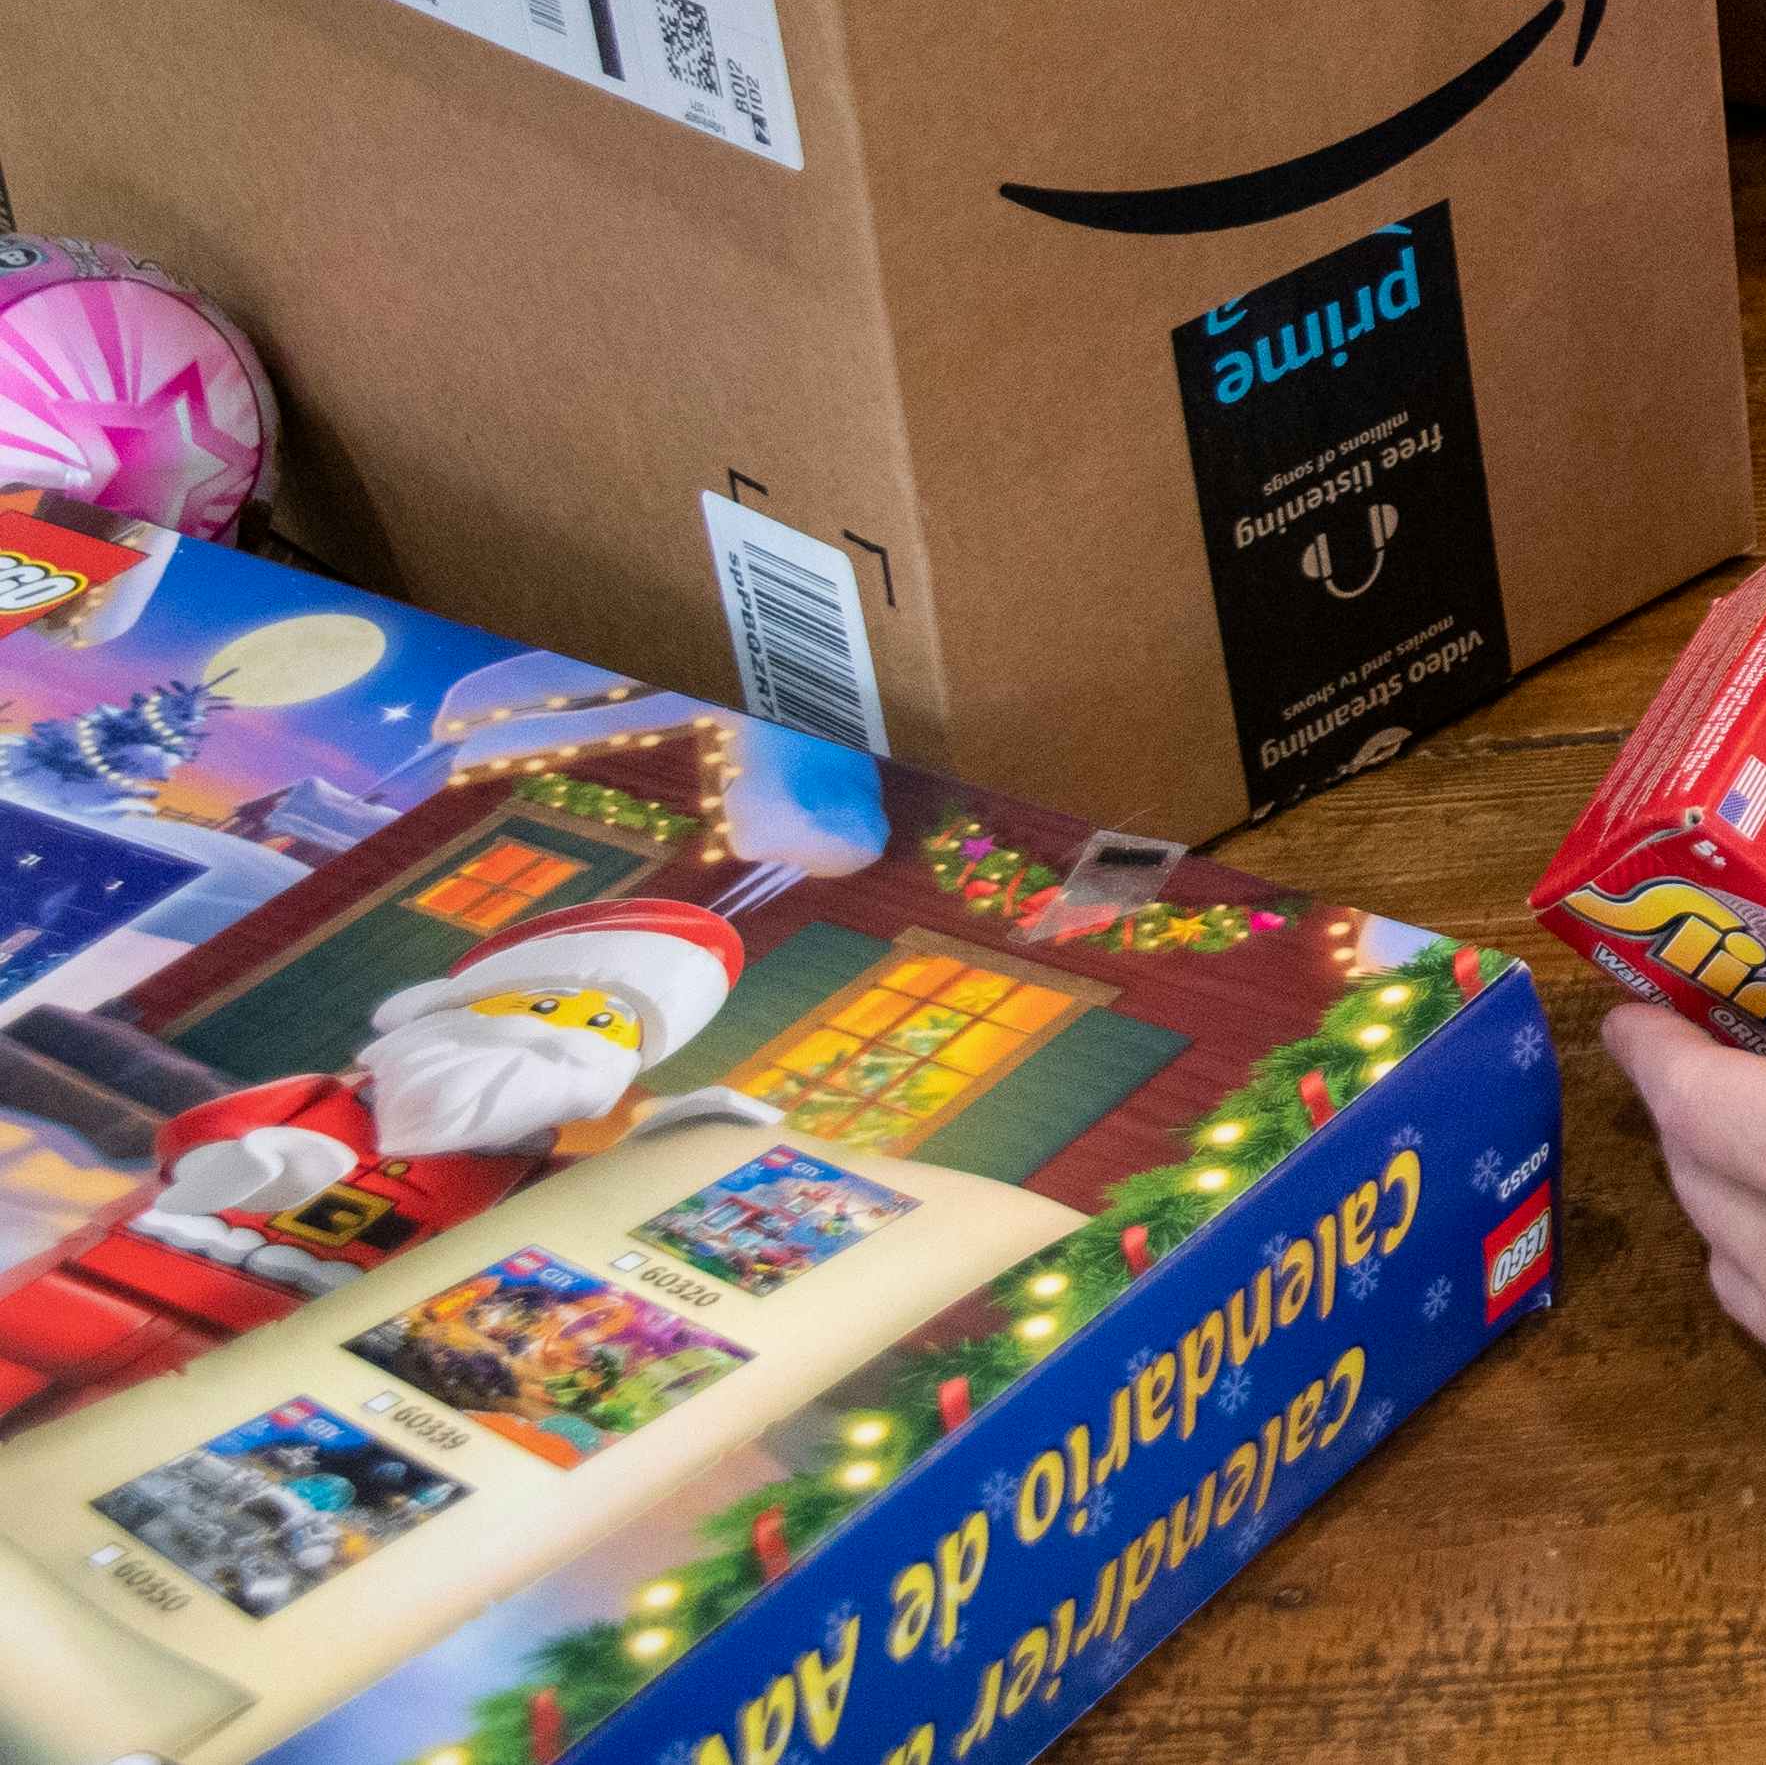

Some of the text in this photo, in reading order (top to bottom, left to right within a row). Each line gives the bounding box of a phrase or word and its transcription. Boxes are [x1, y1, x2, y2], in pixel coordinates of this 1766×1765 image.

[1213, 245, 1421, 405] prime
[1234, 423, 1444, 549] free listening
[1262, 410, 1409, 496] millions of songs
[1261, 629, 1484, 770] video streaming
[1283, 614, 1455, 723] movies and tv shows
[1691, 838, 1728, 869] 5+
[1500, 1142, 1550, 1200] 60352
[640, 1265, 721, 1307] 60320
[1493, 1211, 1550, 1294] LEGO
[393, 1405, 471, 1450] 60339
[888, 1148, 1422, 1661] Calendario de
[955, 1346, 1366, 1756] Calendrier
